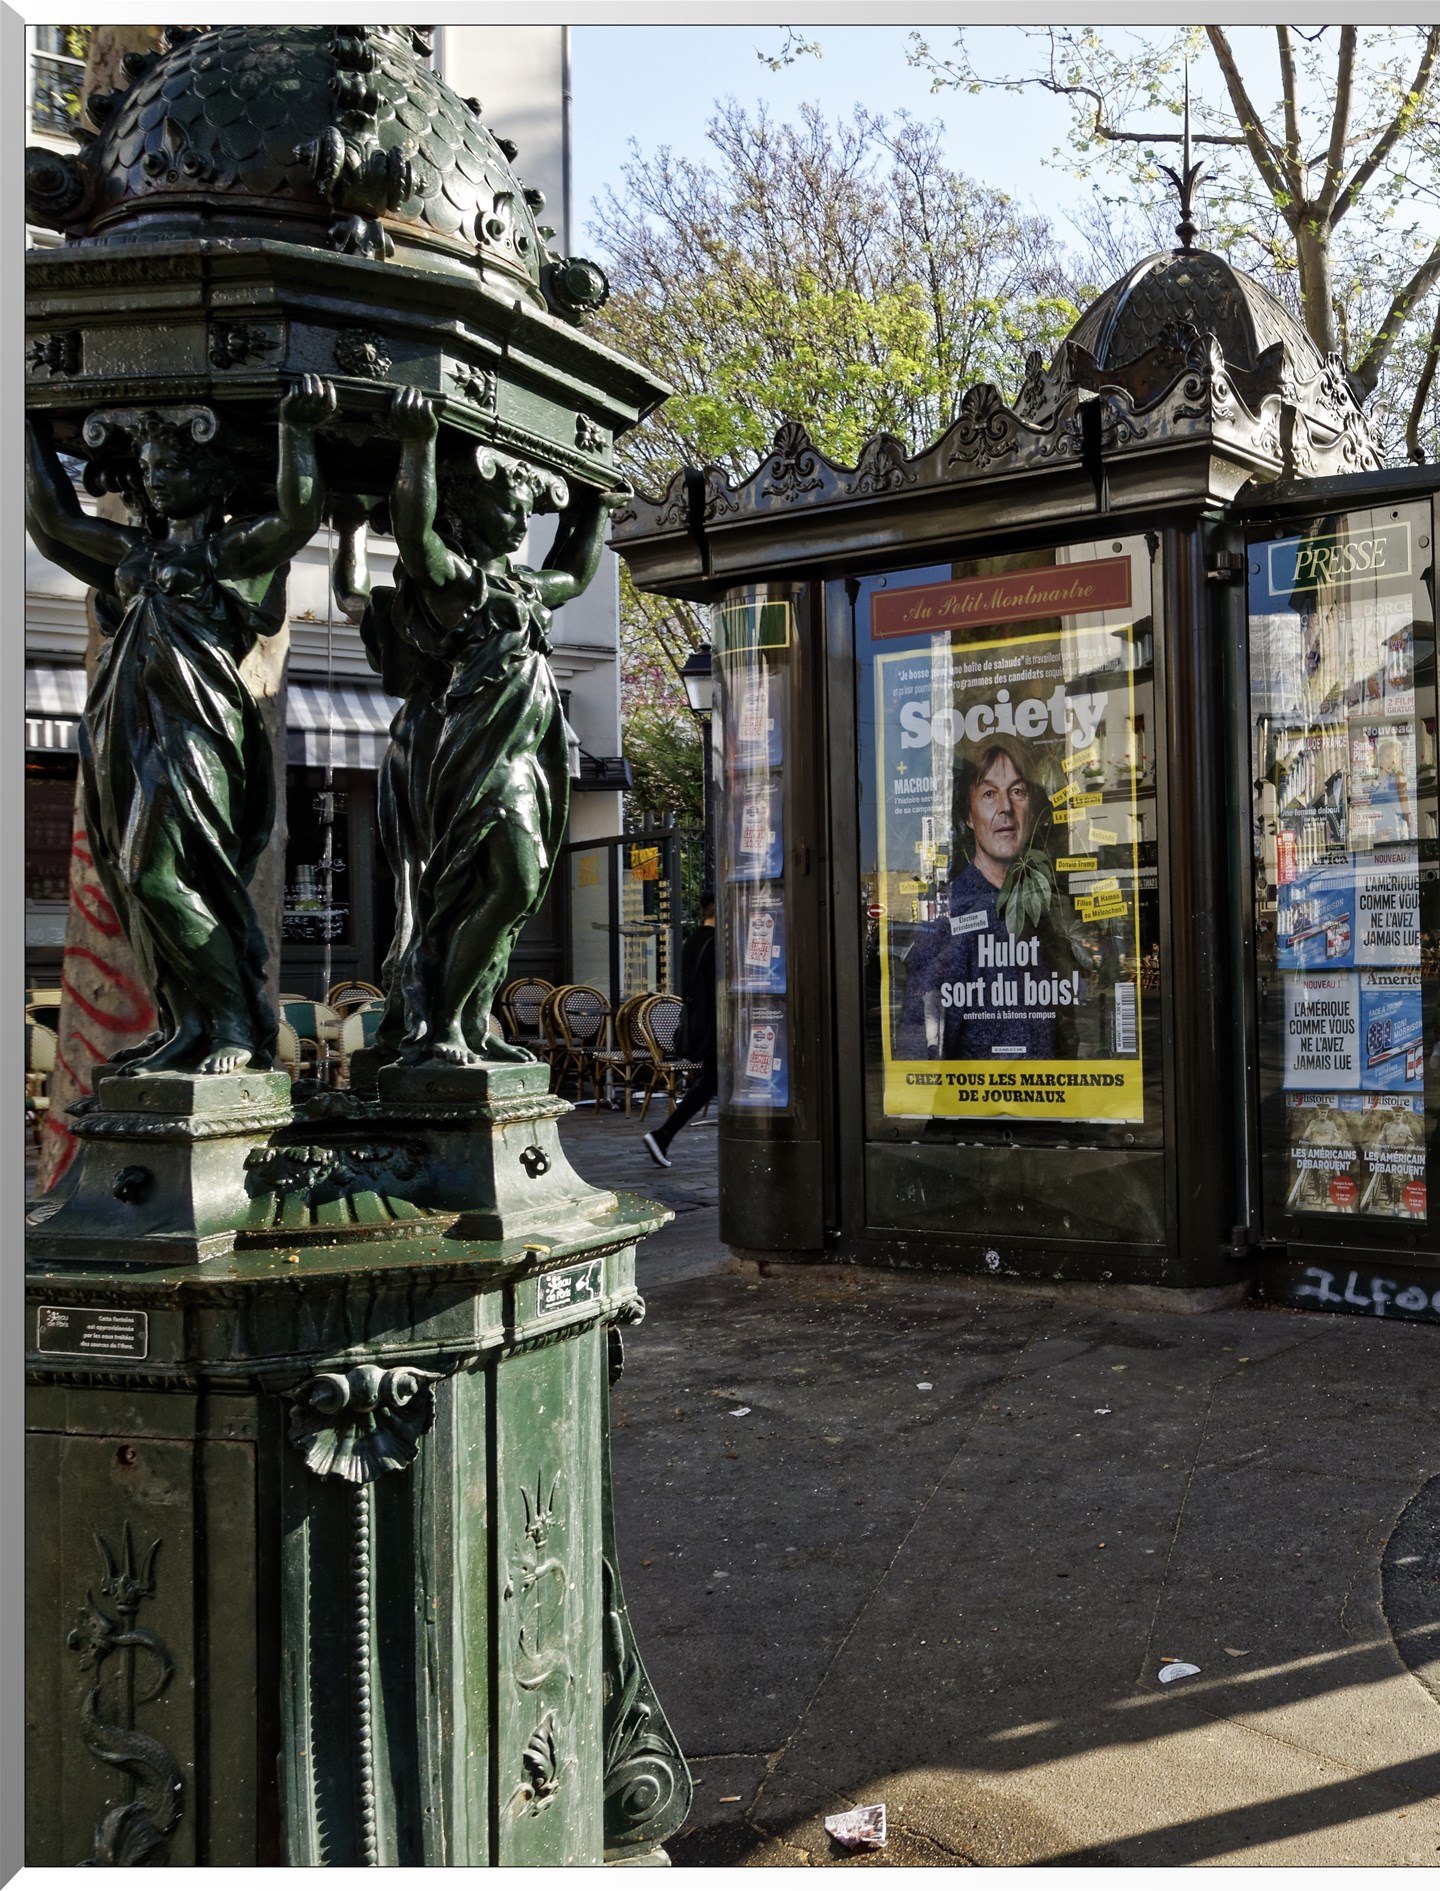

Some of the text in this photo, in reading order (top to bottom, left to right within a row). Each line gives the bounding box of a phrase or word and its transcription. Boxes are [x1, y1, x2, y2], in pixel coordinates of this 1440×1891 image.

[1291, 538, 1387, 583] PRESSE
[903, 578, 1096, 622] Au Petit Montmartre
[908, 669, 929, 680] bosse
[983, 660, 993, 671] de
[1033, 652, 1061, 664] travaillent
[994, 668, 1044, 684] des candidats
[900, 685, 1108, 749] Society
[25, 718, 73, 749] TIT
[1363, 724, 1413, 737] Nouveau
[894, 776, 938, 795] MACRON
[894, 807, 903, 815] de
[1055, 813, 1061, 821] La
[1058, 860, 1096, 869] Donald Trump
[1374, 854, 1406, 864] NOUVEAU
[1365, 873, 1420, 892] L'AMÉRIQUE
[1100, 893, 1120, 903] Hamon
[1360, 894, 1397, 911] COMME
[953, 919, 987, 933] présidentielle
[1371, 912, 1413, 928] NE L'AVEZ
[1363, 930, 1420, 947] JAMAIS LUE
[978, 932, 1040, 968] Hulot
[1304, 980, 1334, 990] NOUVEAU
[1366, 972, 1422, 986] Americ
[940, 970, 1079, 1008] sort du bois!
[963, 1010, 1056, 1020] entretien à bâtons rompus
[1294, 999, 1350, 1017] L'AMÉRIQUE
[1289, 1018, 1355, 1035] COMME VOUS
[1300, 1037, 1345, 1052] NE L'AVEZ
[1293, 1055, 1352, 1070] JAMAIS LUE
[905, 1073, 1125, 1087] CHEZ TOUS LES MARCHANDS
[958, 1090, 1066, 1103] DE JOURNAUX
[1291, 1147, 1357, 1160] LES AMÉRICAINS
[1364, 1151, 1426, 1165] LES AMÉRICAIN
[1296, 1158, 1351, 1171] DÉBARQUENT
[1369, 1161, 1424, 1176] DÉBARQUENT
[546, 1287, 572, 1303] de Paris
[98, 1315, 112, 1323] Cette
[83, 1332, 93, 1340] par
